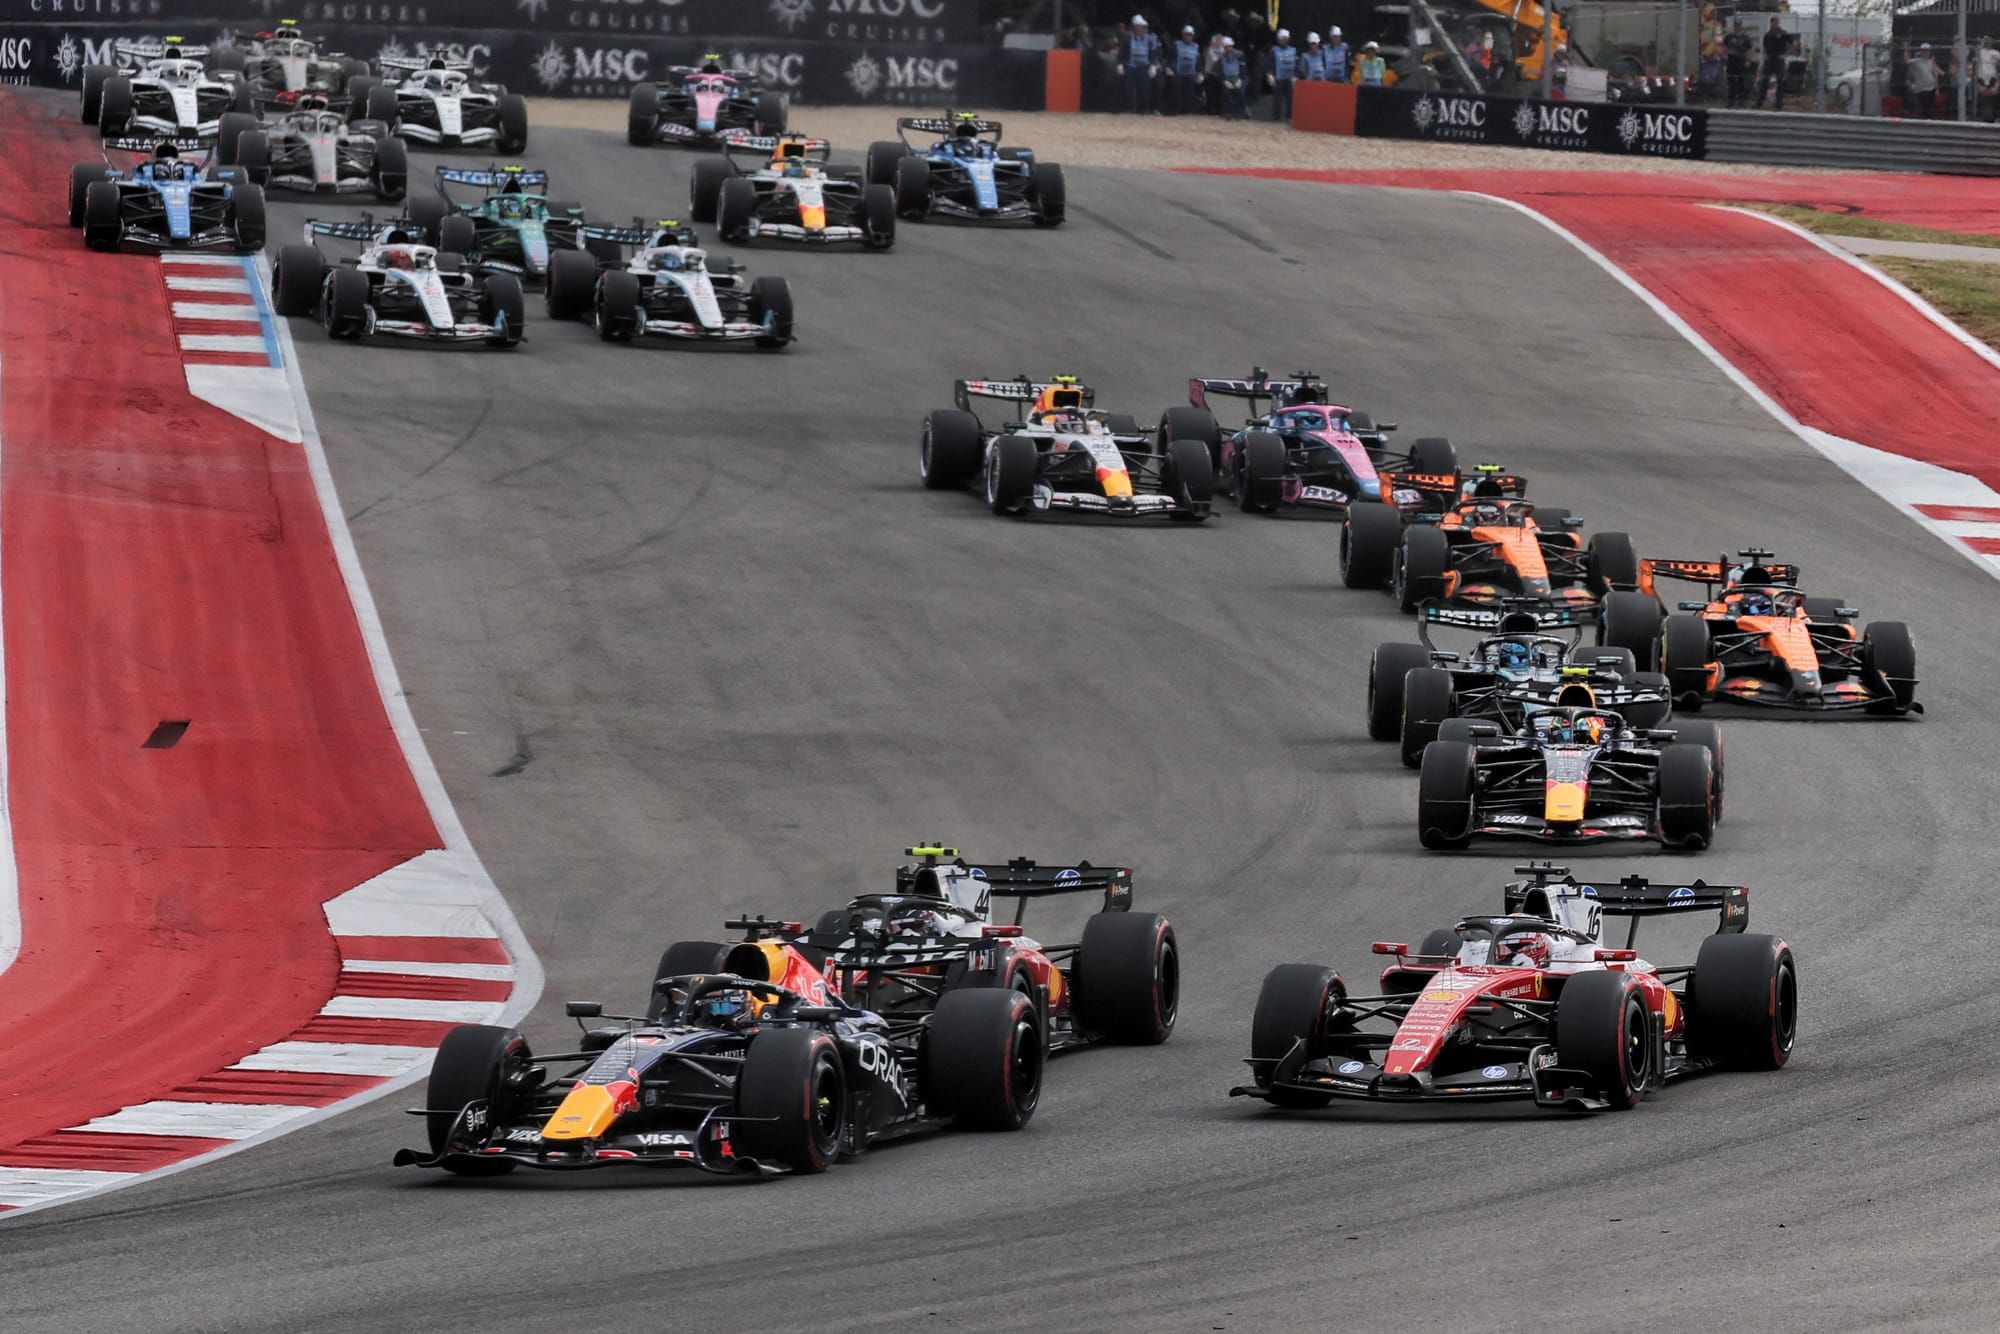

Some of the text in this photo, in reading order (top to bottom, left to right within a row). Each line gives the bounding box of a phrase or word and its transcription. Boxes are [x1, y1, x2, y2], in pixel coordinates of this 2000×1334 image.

[572, 47, 649, 81] MSC
[886, 57, 958, 90] MSC
[1438, 98, 1486, 127] MSC
[1538, 105, 1588, 134] MSC
[1644, 113, 1692, 142] MSC
[1494, 816, 1528, 824] VISA
[1602, 817, 1643, 826] VISA
[975, 889, 991, 922] 44
[1586, 905, 1601, 941] 16
[636, 1134, 690, 1145] VISA
